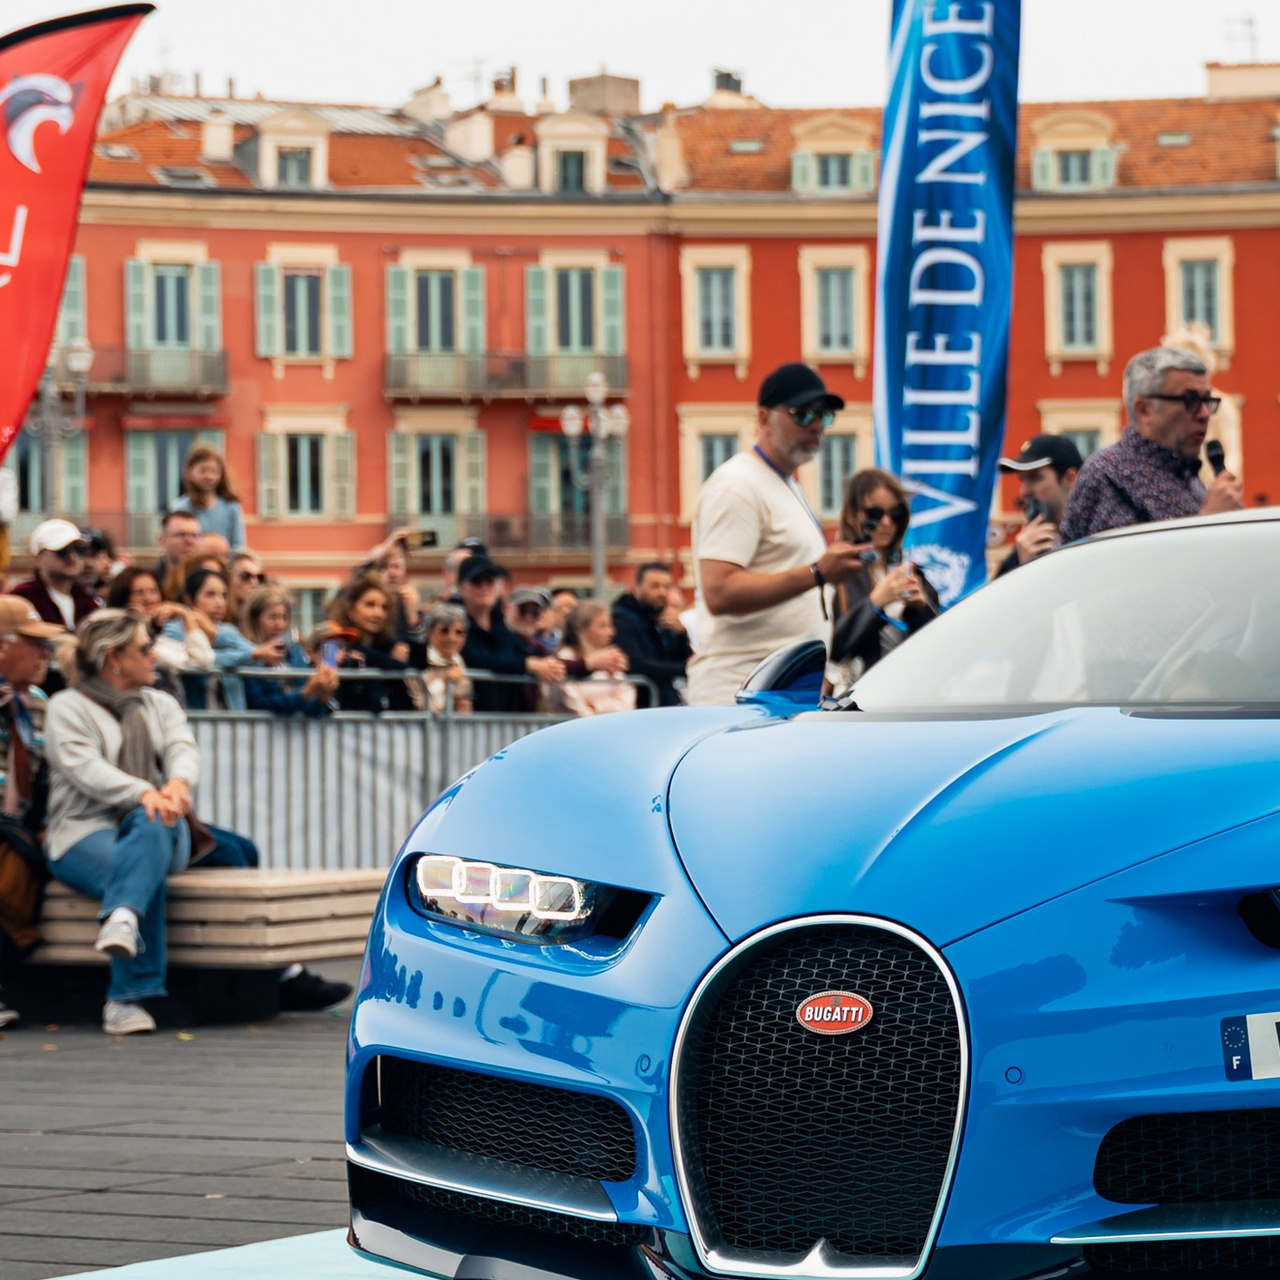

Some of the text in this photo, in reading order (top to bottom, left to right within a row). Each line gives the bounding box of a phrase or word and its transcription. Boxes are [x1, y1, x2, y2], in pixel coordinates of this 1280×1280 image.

[900, 0, 996, 529] VILLE DE NICE
[804, 1006, 864, 1023] BUGATTI
[1232, 1055, 1242, 1070] F
